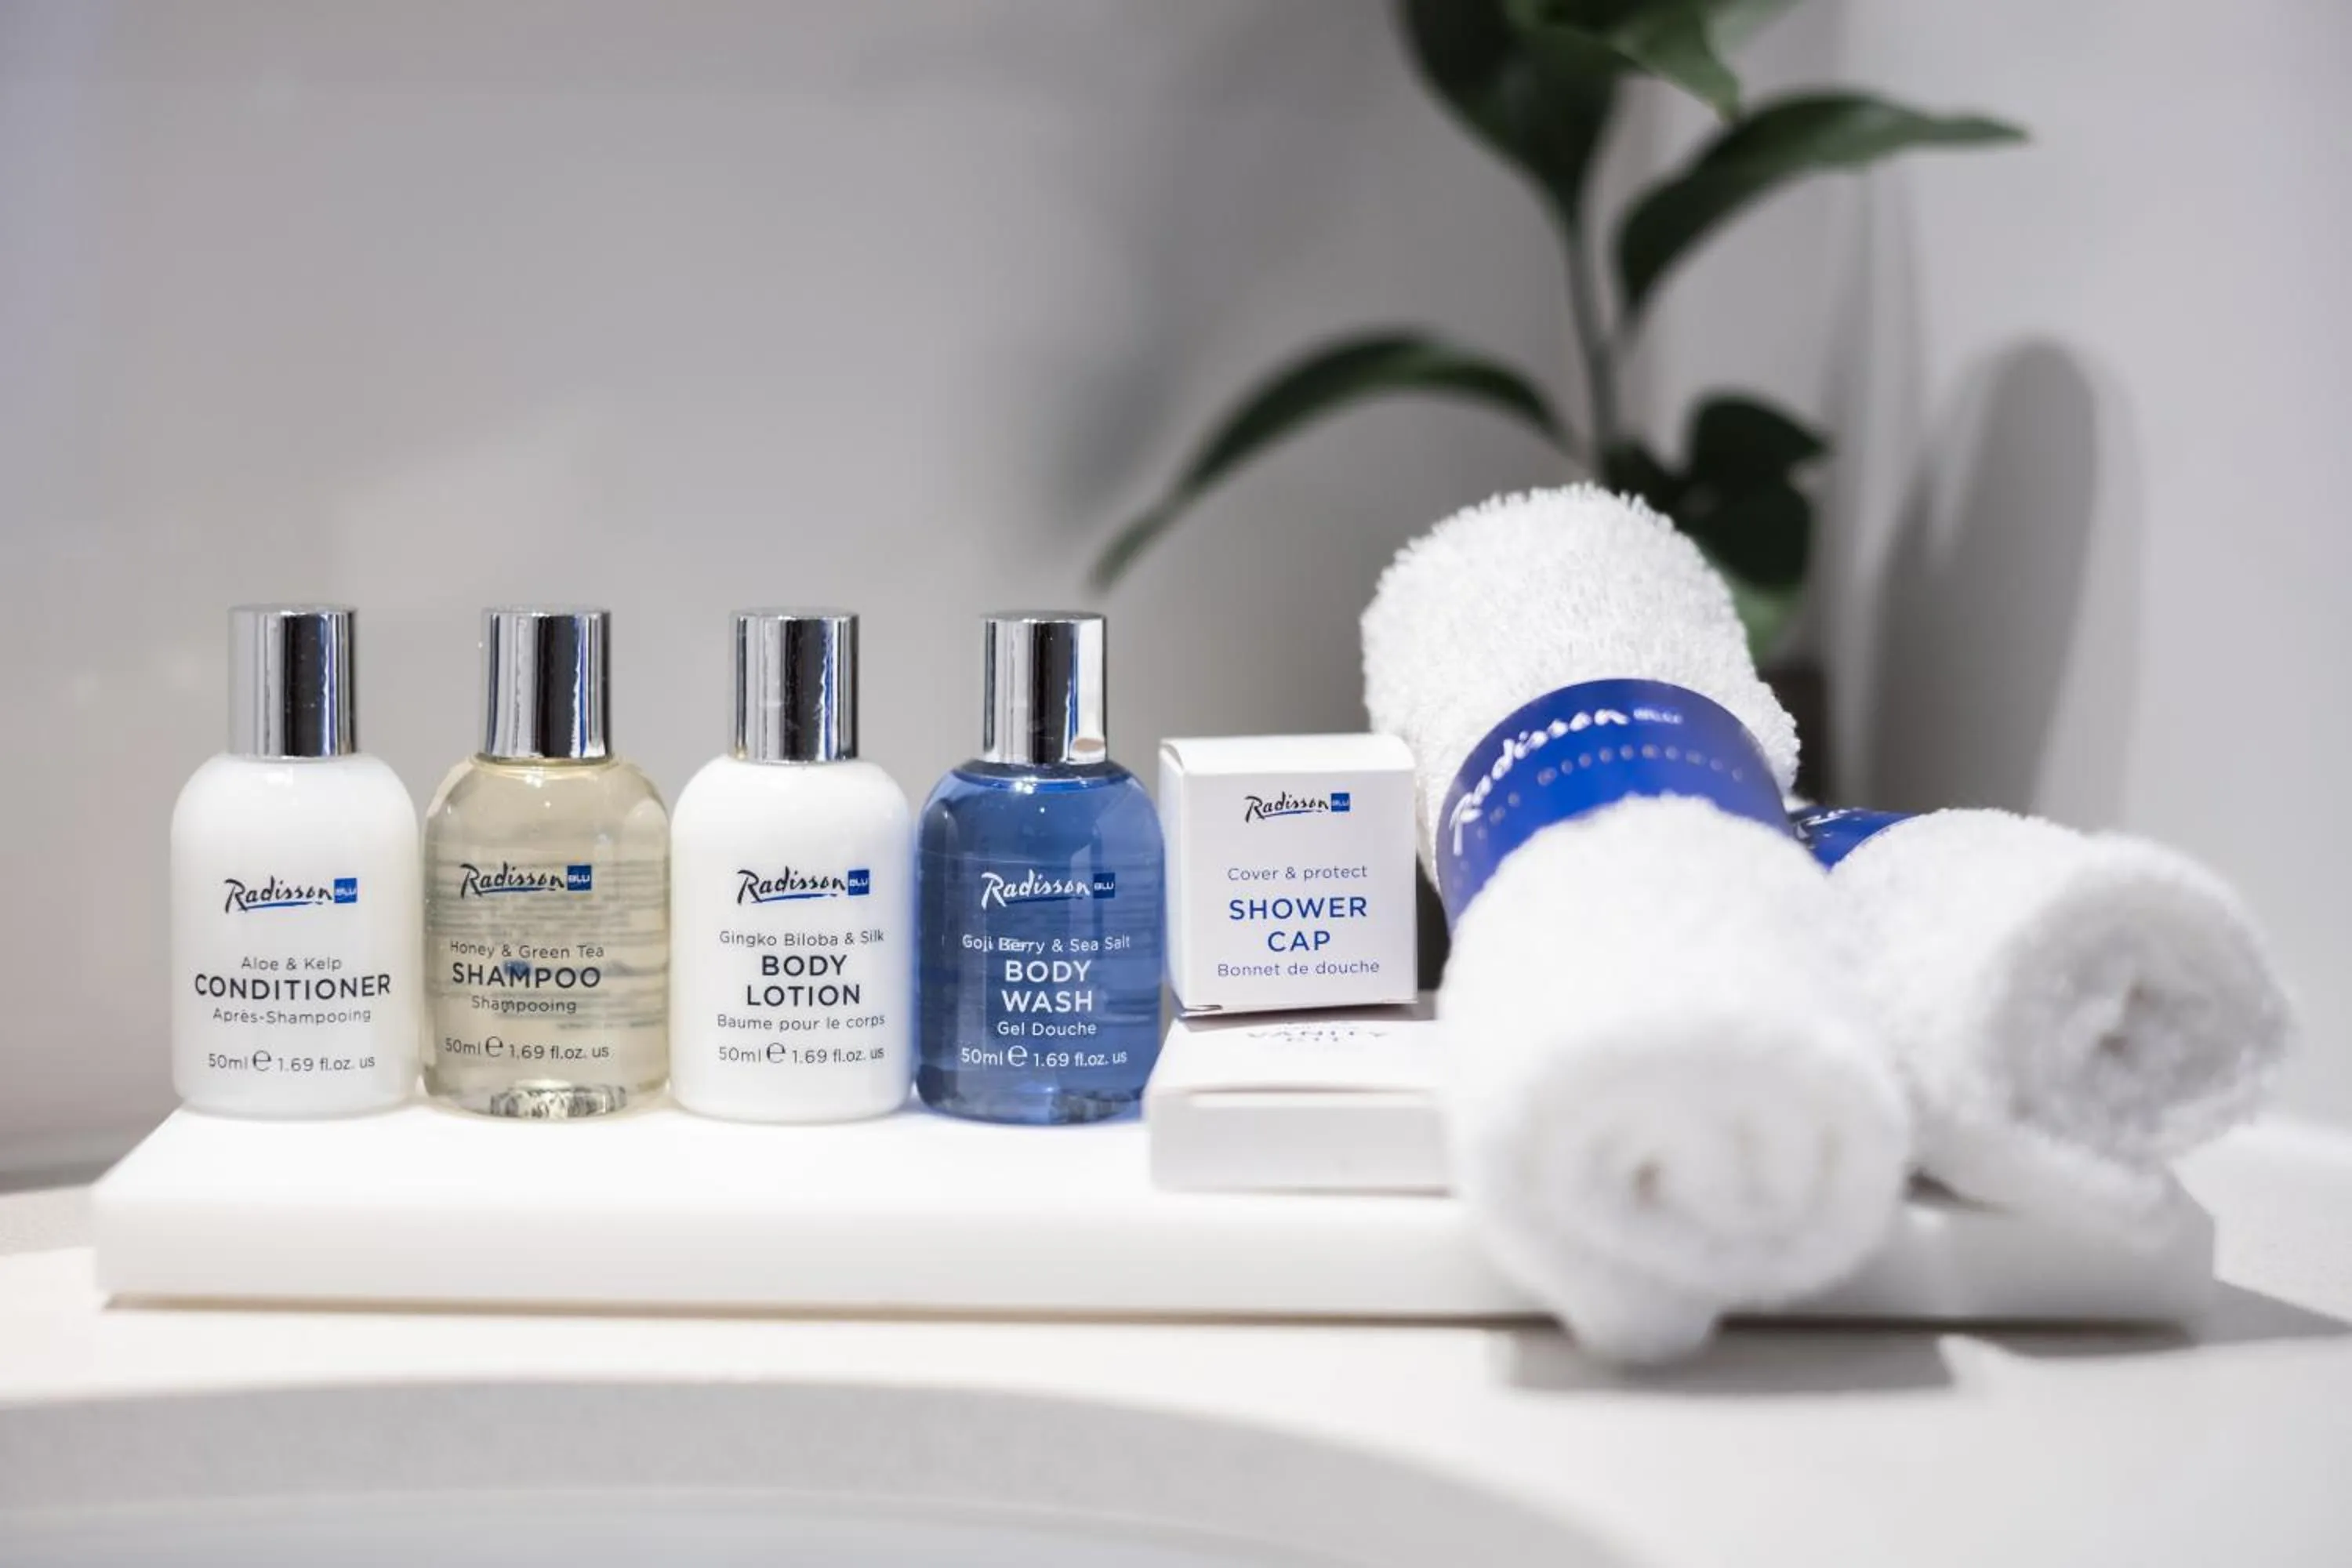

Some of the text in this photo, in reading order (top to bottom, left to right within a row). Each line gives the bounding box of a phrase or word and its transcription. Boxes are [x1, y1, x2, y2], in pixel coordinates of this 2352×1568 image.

[1450, 709, 1628, 855] Radisson
[1243, 791, 1329, 823] Radisson
[459, 861, 565, 899] Radisson
[1228, 865, 1367, 882] Cover & protect
[225, 875, 332, 914] Radisson
[737, 866, 846, 906] Radisson
[981, 869, 1091, 909] Radisson
[1229, 897, 1367, 920] SHOWER
[719, 929, 884, 948] Gingko Biloba & Silk
[962, 934, 1130, 955] Goji Berry & Sea Salt
[1267, 931, 1330, 952] CAP
[450, 941, 604, 959] Honey & Green Tea
[241, 956, 343, 971] Aloe & Kelp
[761, 954, 848, 977] BODY
[1005, 960, 1091, 982] BODY
[1218, 960, 1380, 977] Bonnet de douche
[452, 962, 601, 989] SHAMPOO
[194, 973, 391, 1000] CONDITIONER
[747, 984, 860, 1007] LOTION
[471, 995, 577, 1014] Shampooing
[1001, 990, 1093, 1013] WASH
[212, 1008, 371, 1025] Après-Shampooing
[717, 1014, 885, 1033] Baume pour le corps
[997, 1022, 1097, 1036] Gel Douche
[445, 1037, 481, 1054] 50ml
[510, 1044, 544, 1059] 1.69
[718, 1047, 761, 1063] 50ml
[792, 1050, 827, 1064] 1.69
[960, 1047, 1003, 1066] 50ml
[1033, 1052, 1069, 1067] 1.69
[208, 1053, 248, 1069] 50ml
[278, 1058, 314, 1072] 1.69
